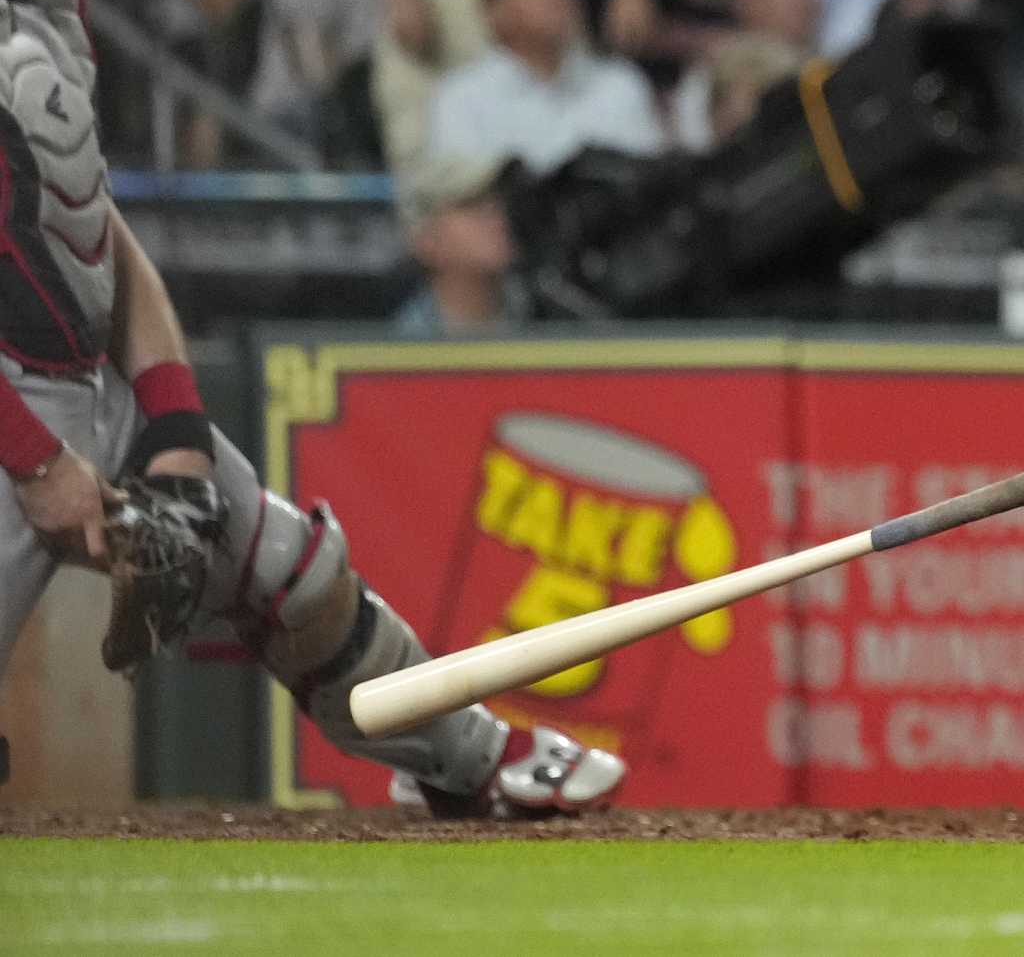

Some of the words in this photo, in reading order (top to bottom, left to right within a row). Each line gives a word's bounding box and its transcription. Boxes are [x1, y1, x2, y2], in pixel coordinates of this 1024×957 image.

[477, 450, 671, 586] TAKE
[757, 460, 898, 529] THE
[766, 621, 845, 693] 10
[764, 694, 874, 771] OIL
